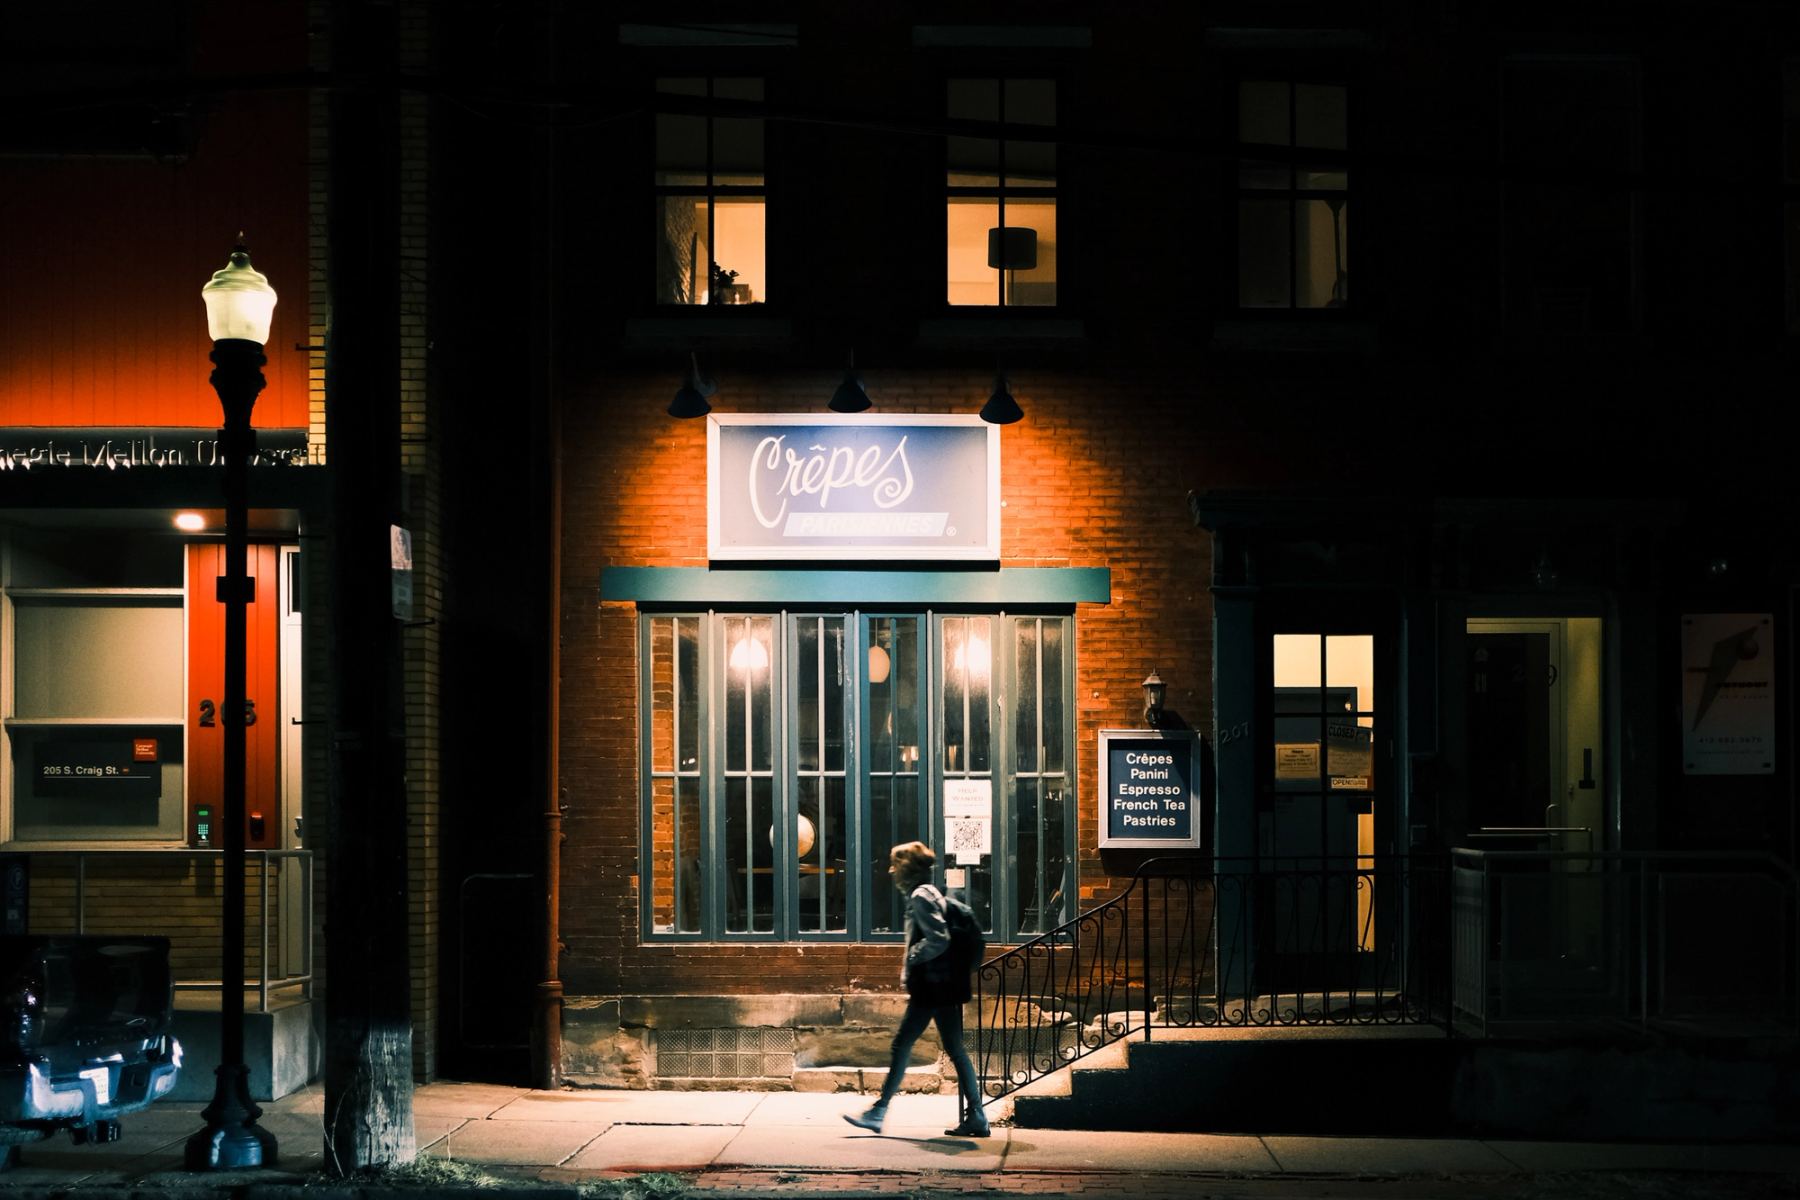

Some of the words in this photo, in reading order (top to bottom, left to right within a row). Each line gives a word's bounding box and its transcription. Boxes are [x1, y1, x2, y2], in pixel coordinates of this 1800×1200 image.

[749, 434, 914, 528] Crêpes
[198, 698, 258, 727] 25
[1220, 721, 1249, 744] 207
[1126, 752, 1174, 766] Crêpes
[43, 765, 62, 775] 205
[63, 765, 74, 775] S.
[75, 765, 103, 777] Craig
[105, 765, 119, 775] St.
[1130, 768, 1169, 780] Panini
[1119, 783, 1181, 797] Espresso
[1113, 798, 1158, 811] French
[1163, 798, 1186, 811] Tea
[1123, 814, 1176, 826] Pastries
